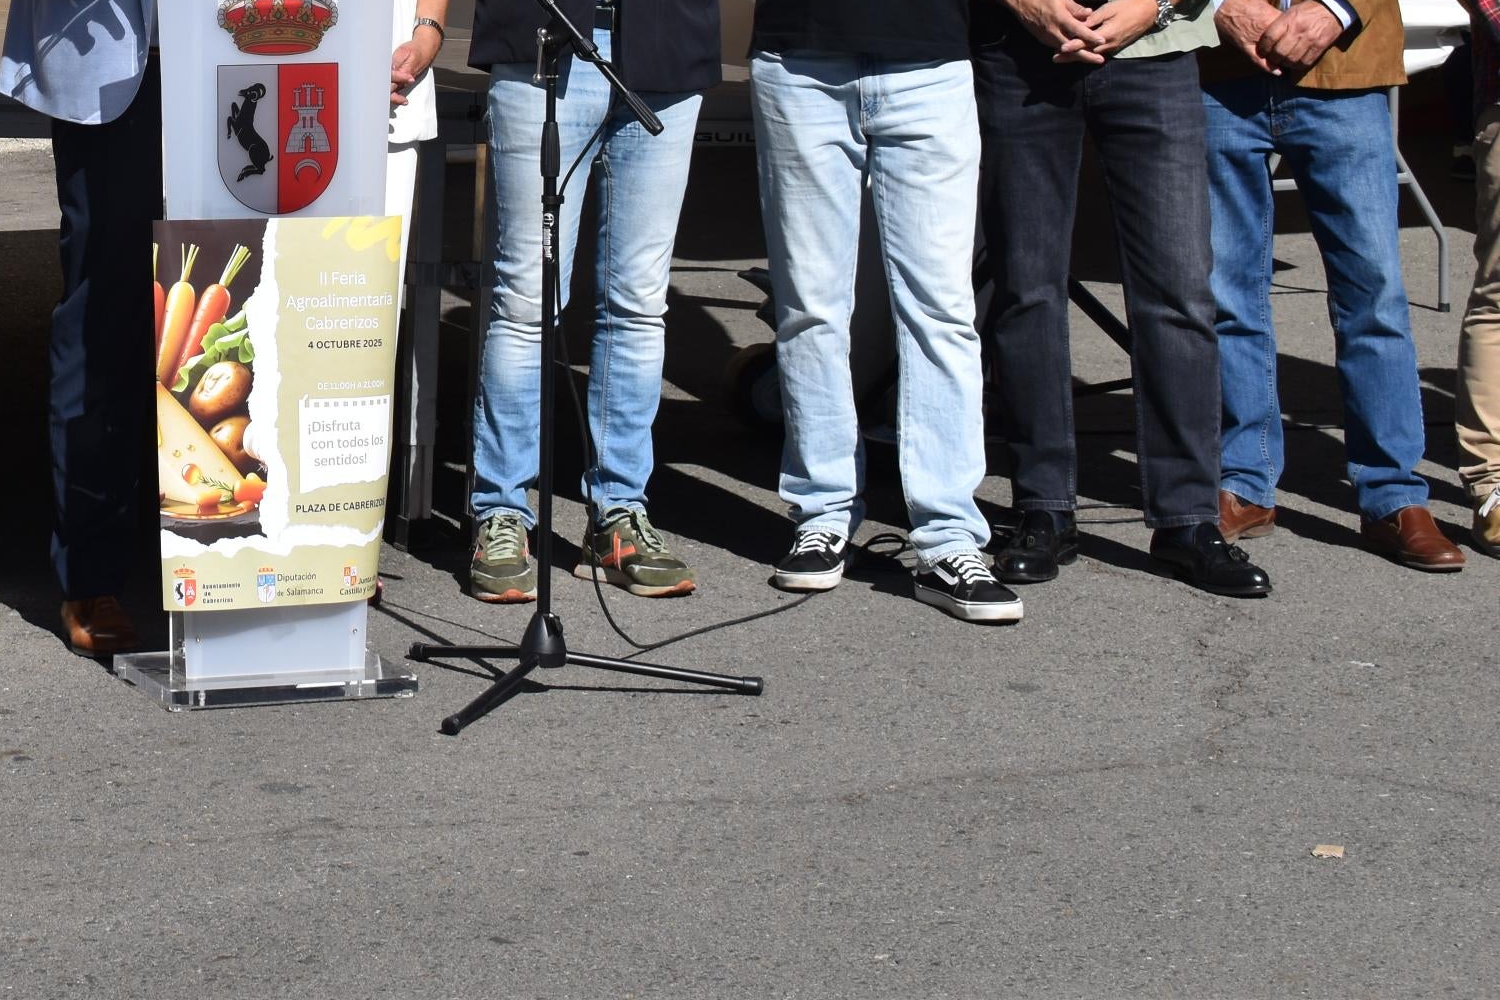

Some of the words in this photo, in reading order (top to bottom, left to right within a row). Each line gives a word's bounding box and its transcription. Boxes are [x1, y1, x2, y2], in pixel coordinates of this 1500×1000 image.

[694, 131, 756, 142] GUIL
[319, 271, 327, 286] II
[331, 271, 366, 286] Feria
[286, 292, 393, 312] Agroalimentaria
[305, 315, 379, 330] Cabrerizos
[307, 341, 314, 349] 4
[316, 339, 361, 349] OCTUBRE
[363, 338, 382, 348] 2025
[308, 420, 361, 435] ¡Disfruta
[311, 440, 334, 450] con
[337, 436, 369, 449] todos
[371, 434, 384, 446] los
[314, 453, 367, 467] sentidos!
[295, 504, 326, 513] PLAZA
[328, 503, 341, 512] DE
[277, 572, 317, 582] Diputación
[202, 582, 241, 590] Ayuntamiento
[339, 587, 362, 596] Castilla
[286, 587, 323, 597] Salamanca
